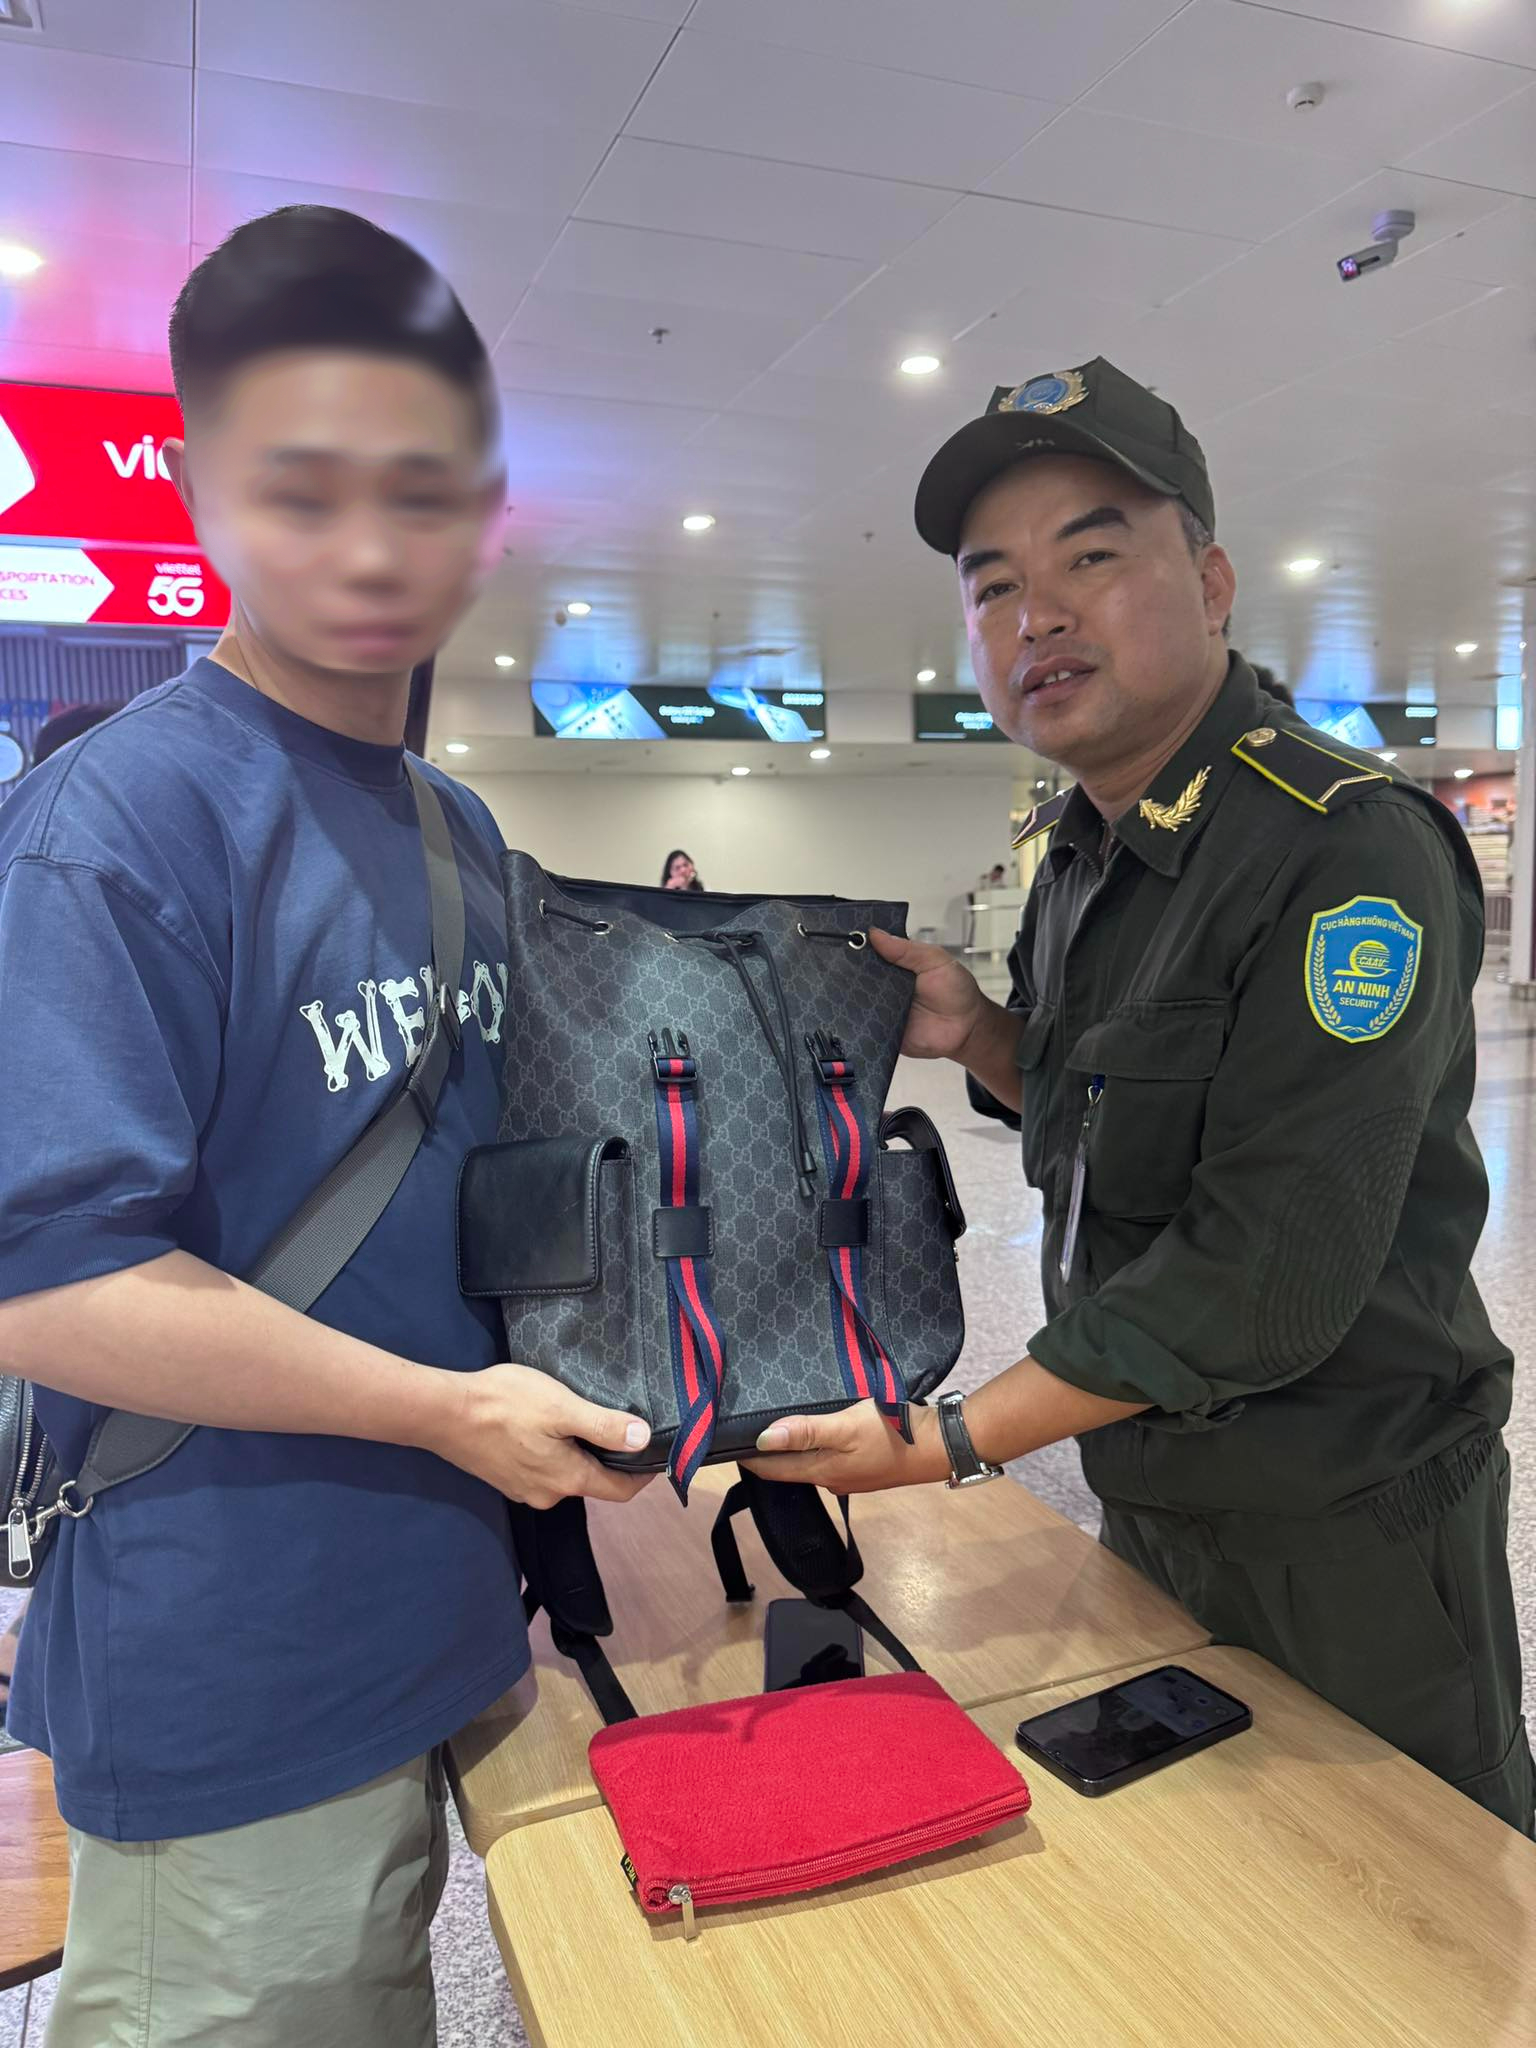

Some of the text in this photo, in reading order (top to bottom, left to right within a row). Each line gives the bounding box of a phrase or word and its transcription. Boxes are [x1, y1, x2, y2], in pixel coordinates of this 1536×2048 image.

[147, 575, 205, 617] 5G
[1332, 979, 1391, 998] AN NINH
[1339, 996, 1380, 1009] SECURITY
